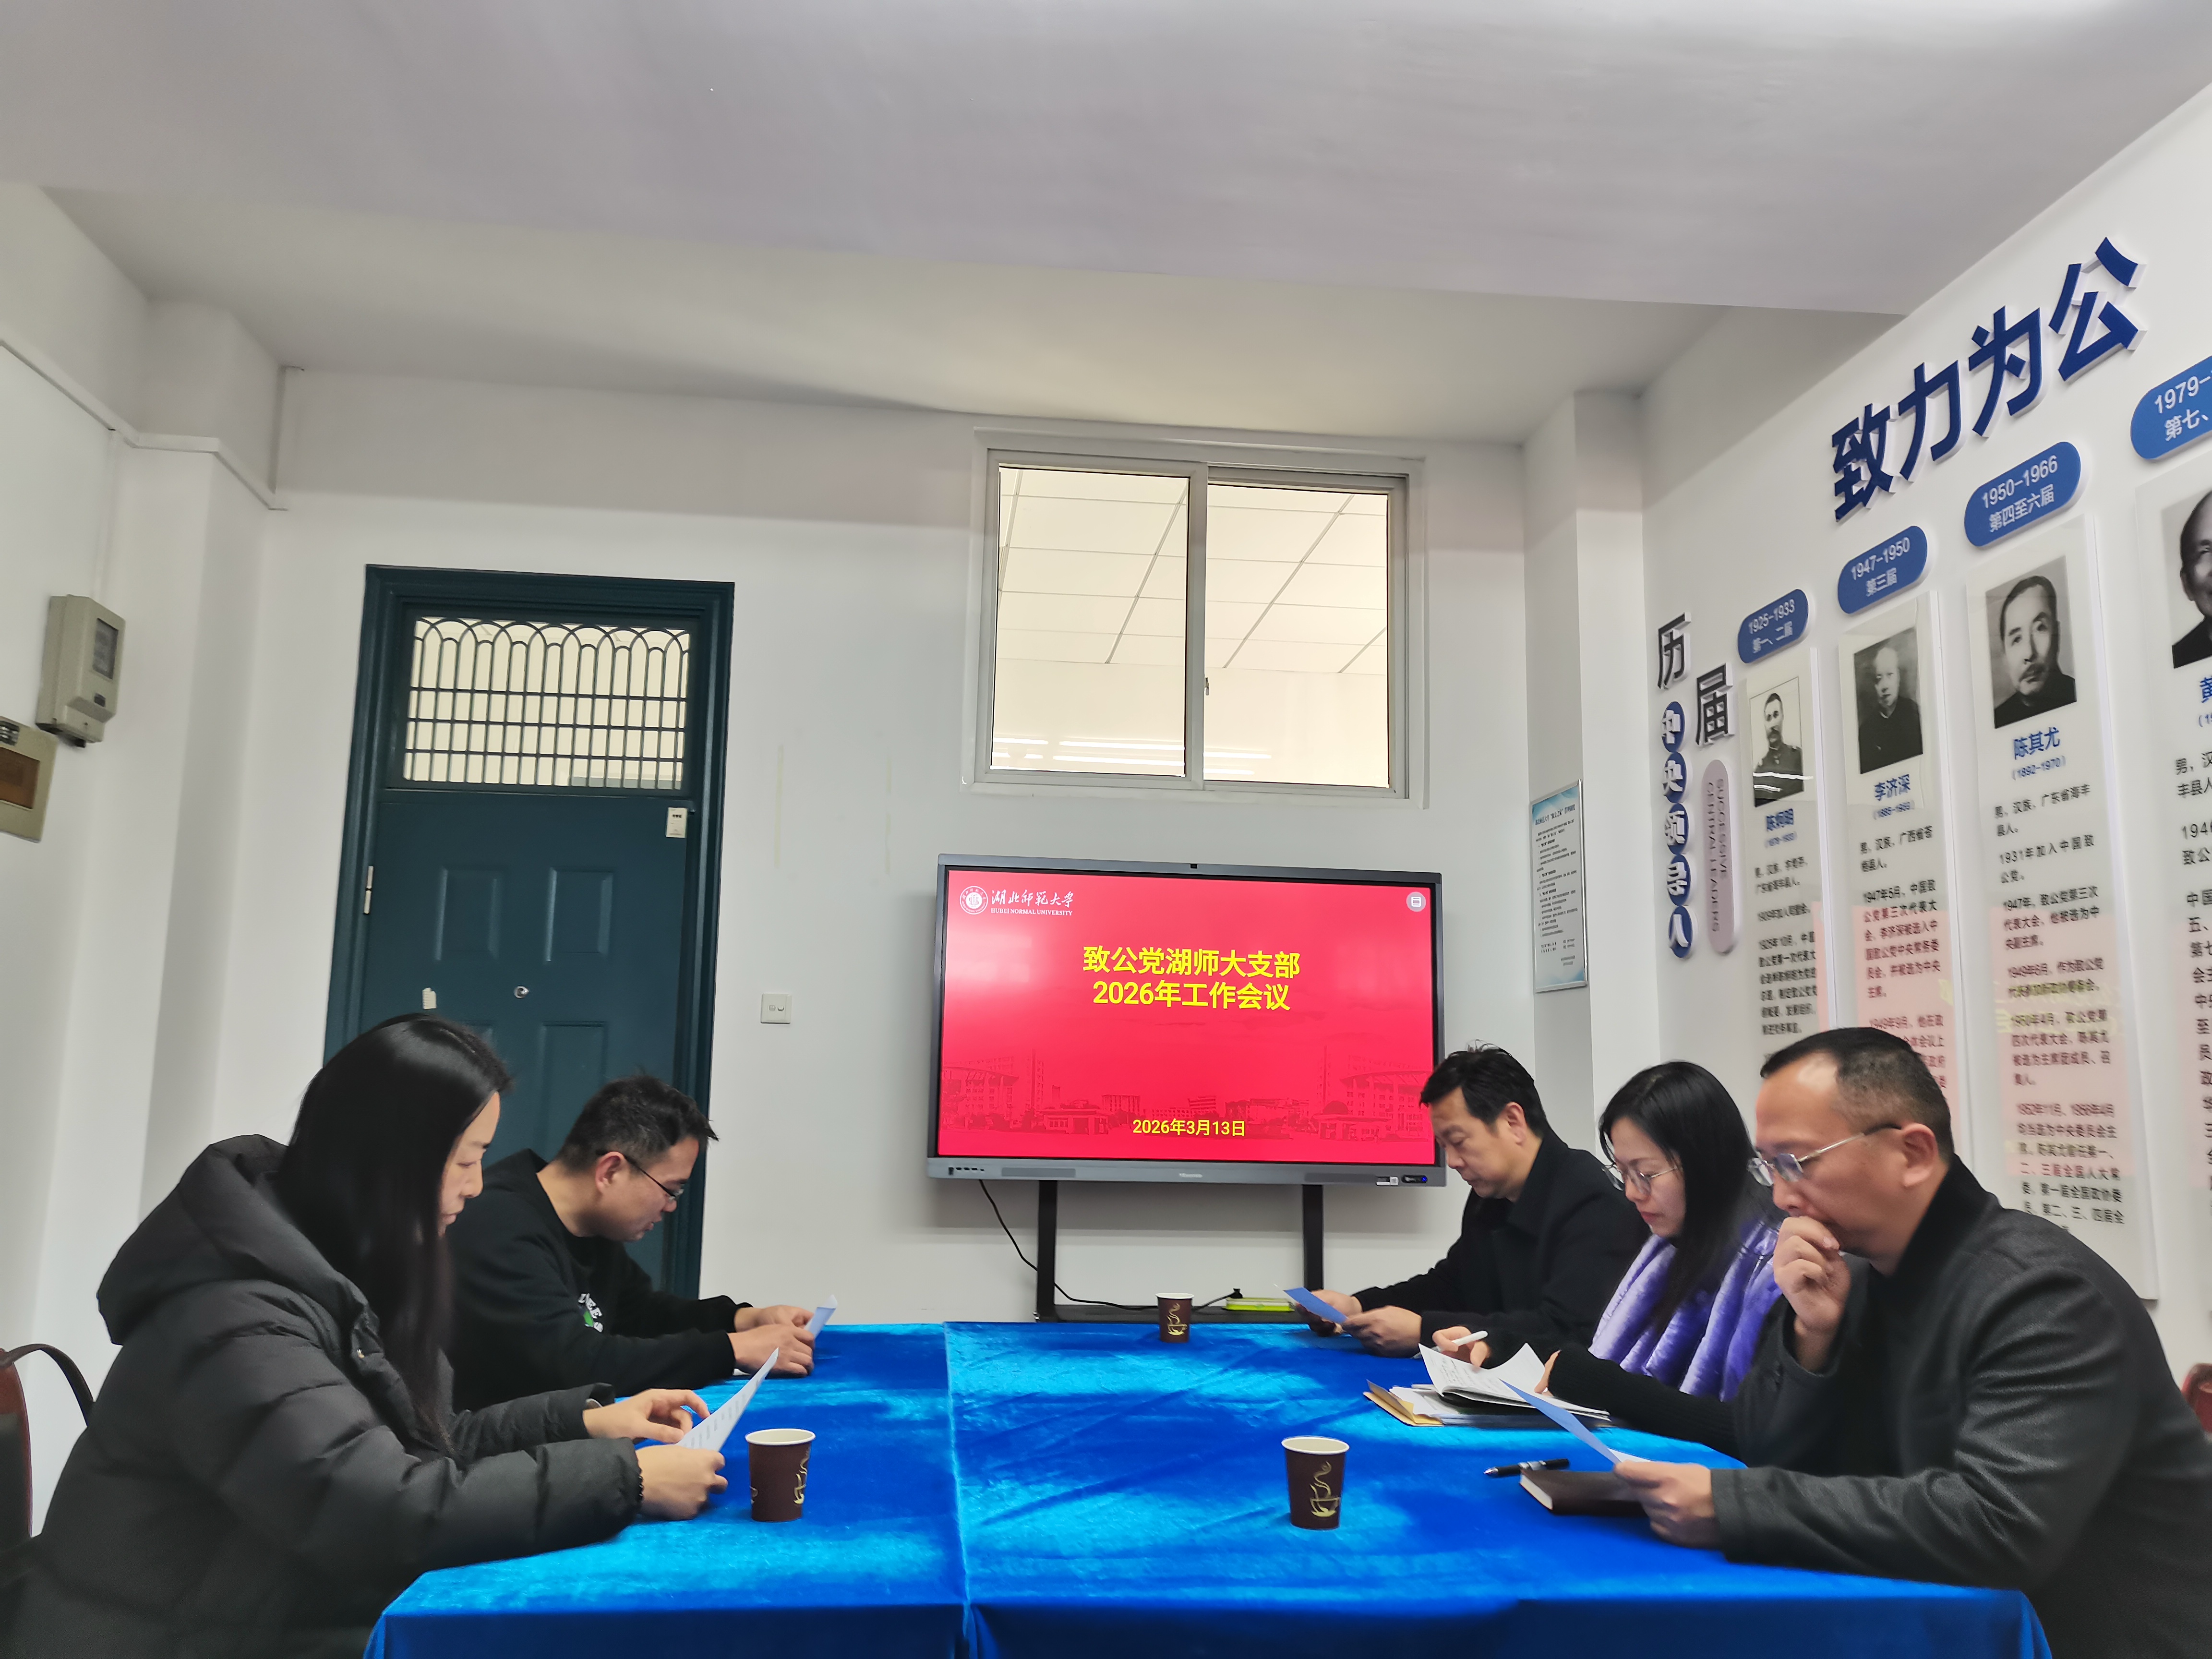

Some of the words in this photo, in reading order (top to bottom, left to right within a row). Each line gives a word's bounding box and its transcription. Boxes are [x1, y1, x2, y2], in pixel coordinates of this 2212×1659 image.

[1831, 237, 2147, 522] 致力为公
[2154, 370, 2212, 413] 1979-
[2164, 409, 2209, 441] 第七、
[1982, 455, 2058, 508] 1950-1966
[1989, 484, 2055, 532] 第四至六届
[1851, 537, 1910, 580] 1947-1950
[1866, 567, 1897, 597] 第三届
[1749, 599, 1795, 634] 1925-1933
[2198, 713, 2212, 728] (1
[2013, 727, 2060, 760] 陈其尤
[1661, 709, 1689, 948] 中央领导人
[2182, 820, 2212, 839] 194
[1082, 945, 1300, 979] 致公党湖师大支部
[1093, 980, 1291, 1010] 2026年工作会议
[2194, 992, 2212, 1009] 中
[1132, 1118, 1245, 1137] 2026年3月13日
